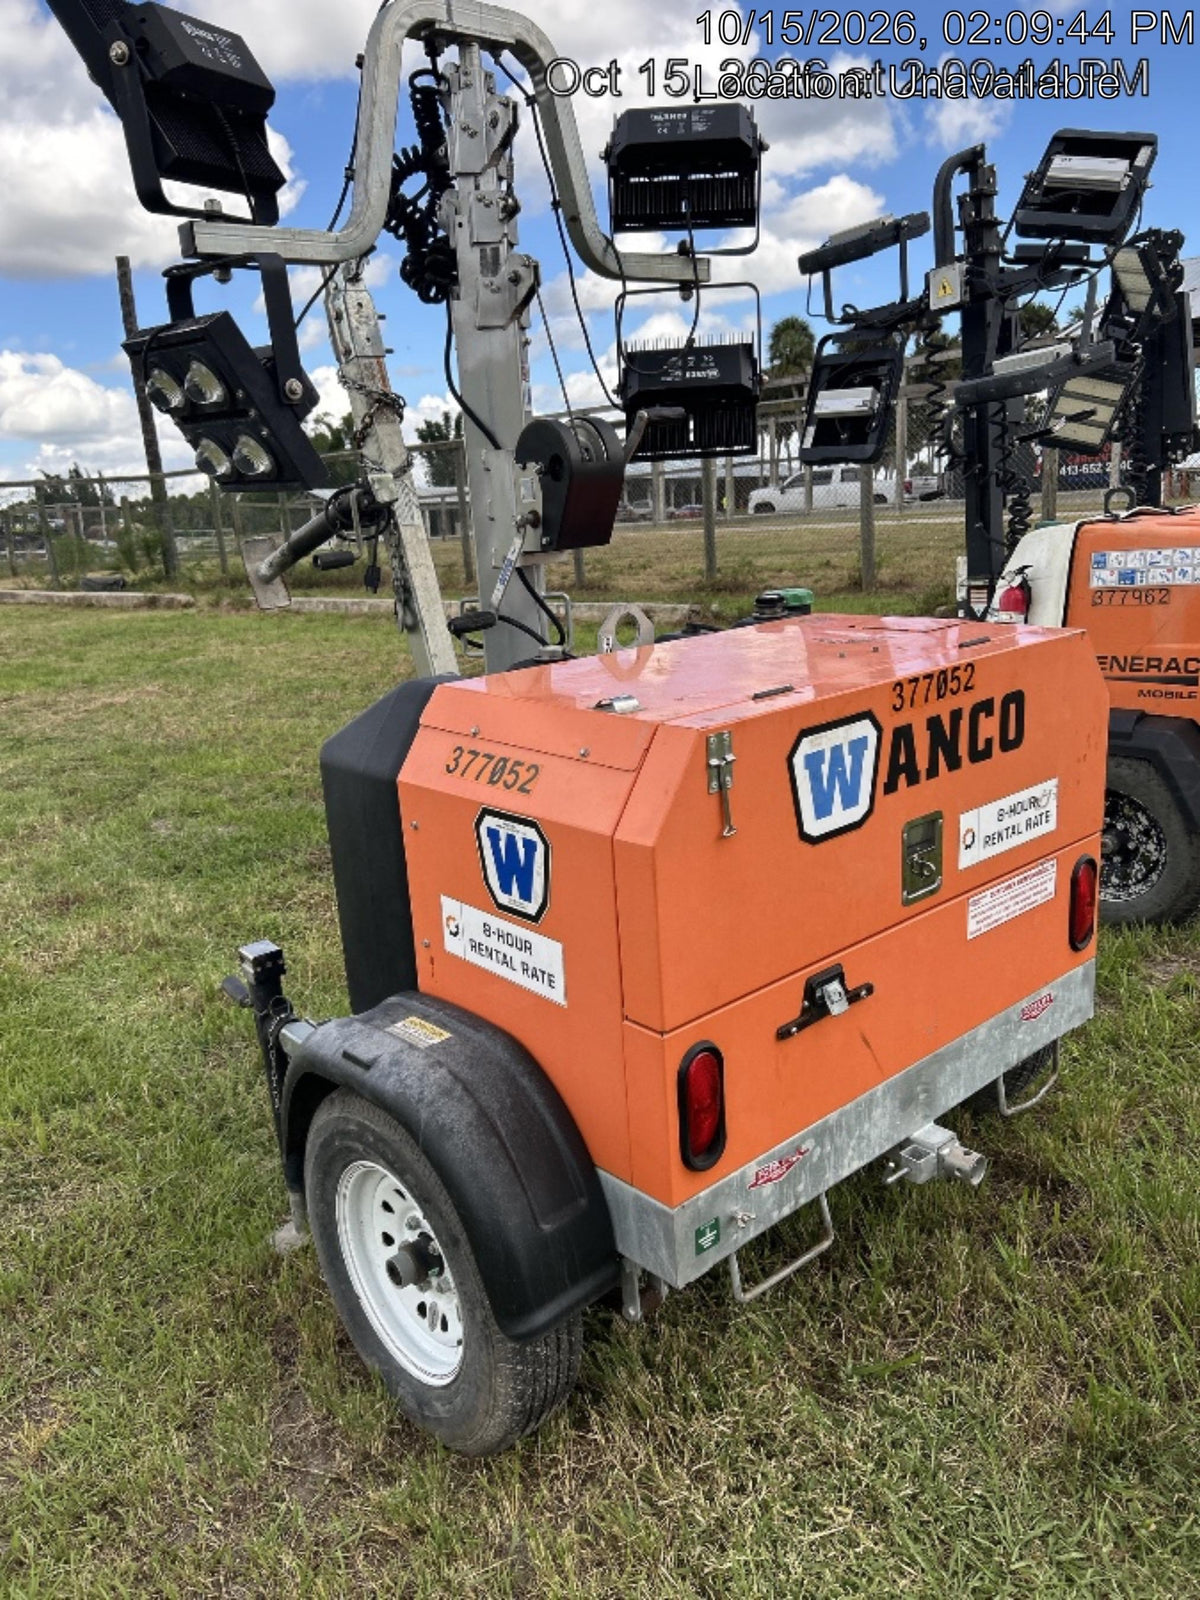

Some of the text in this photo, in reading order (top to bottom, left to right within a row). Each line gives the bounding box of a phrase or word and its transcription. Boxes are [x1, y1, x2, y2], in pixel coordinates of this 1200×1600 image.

[1094, 588, 1170, 606] 377962
[1096, 655, 1200, 674] ENERAC
[891, 662, 976, 713] 377052
[1138, 689, 1198, 700] MOBILE
[445, 745, 540, 795] 377052
[983, 810, 1051, 851] RENTAL RATE
[486, 826, 538, 904] W
[482, 921, 533, 956] 8-HOUR
[468, 936, 557, 991] RENTAL RATE
